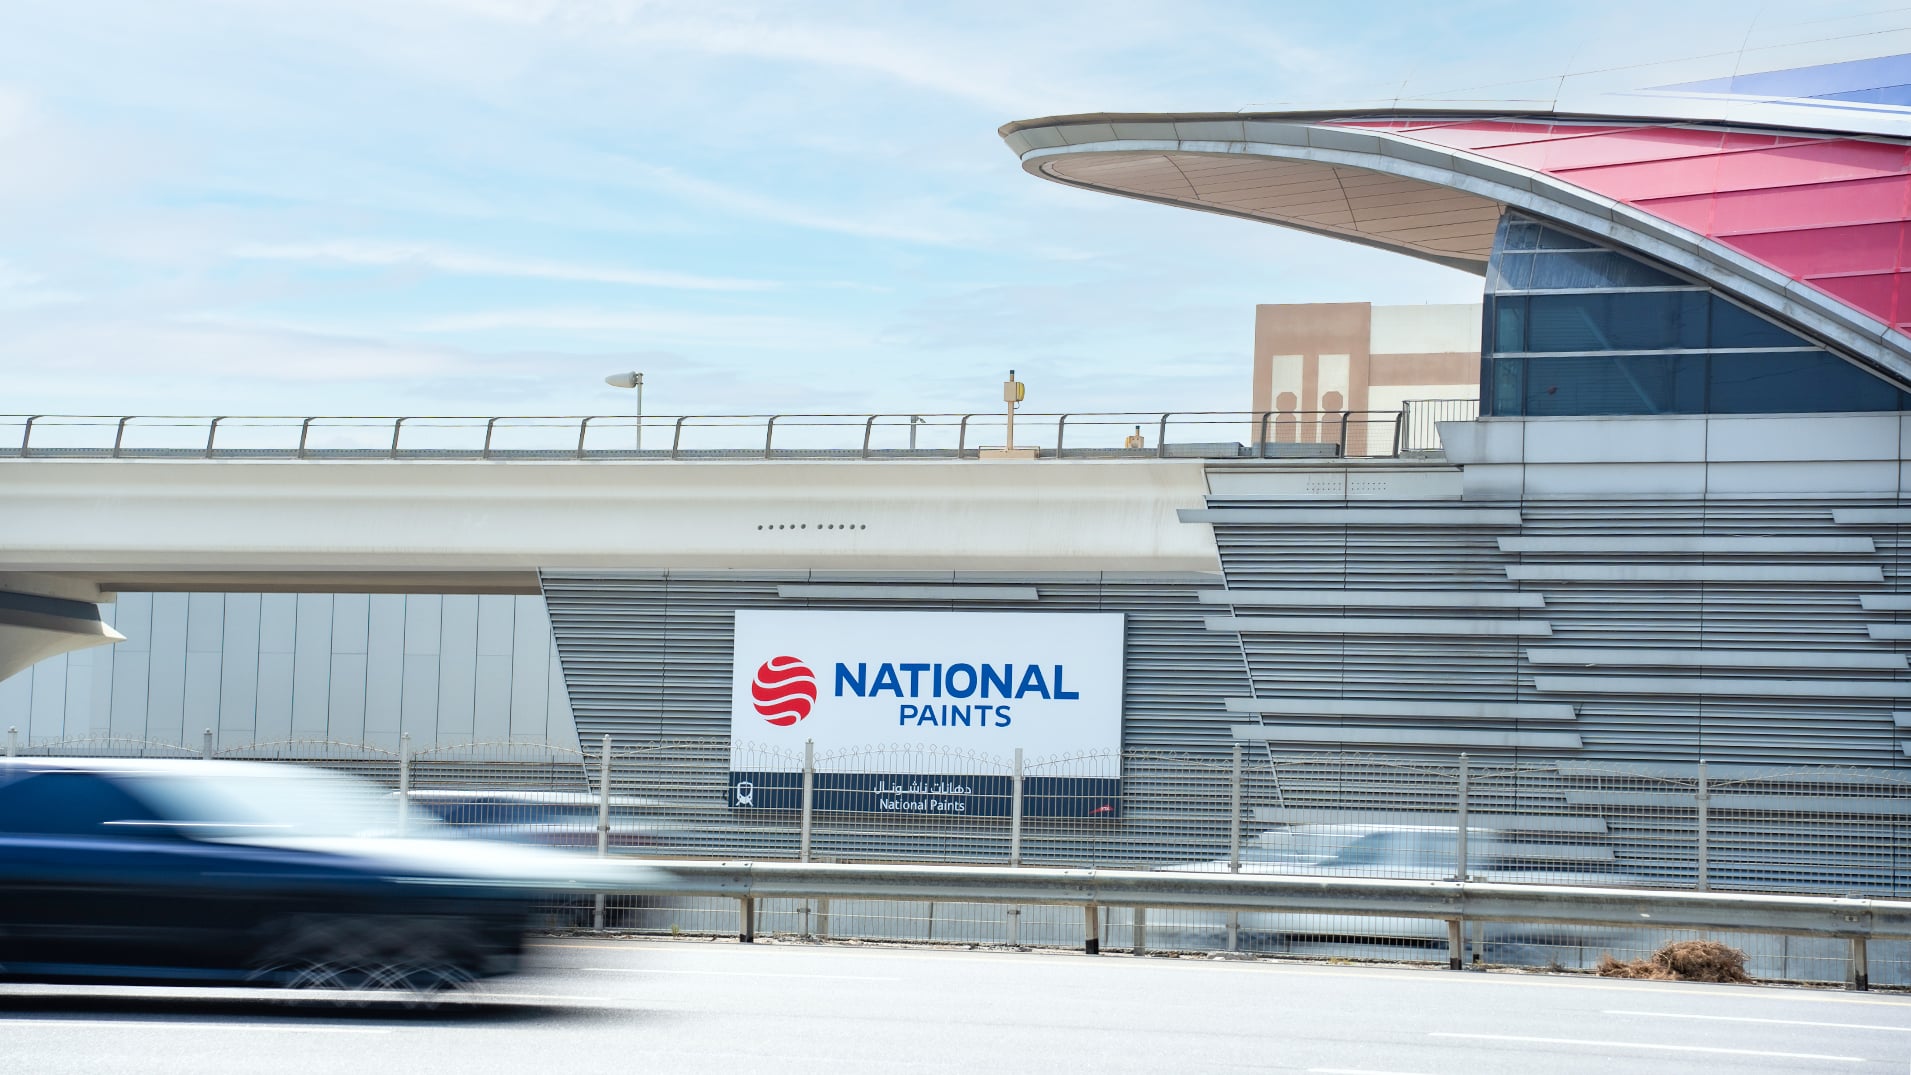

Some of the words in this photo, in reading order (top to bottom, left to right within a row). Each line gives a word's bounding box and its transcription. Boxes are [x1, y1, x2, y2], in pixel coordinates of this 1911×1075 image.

[835, 662, 1079, 700] NATIONAL
[899, 704, 1012, 727] PAINTS
[930, 782, 972, 795] دهانات
[880, 798, 927, 811] National
[930, 800, 965, 811] Paints
